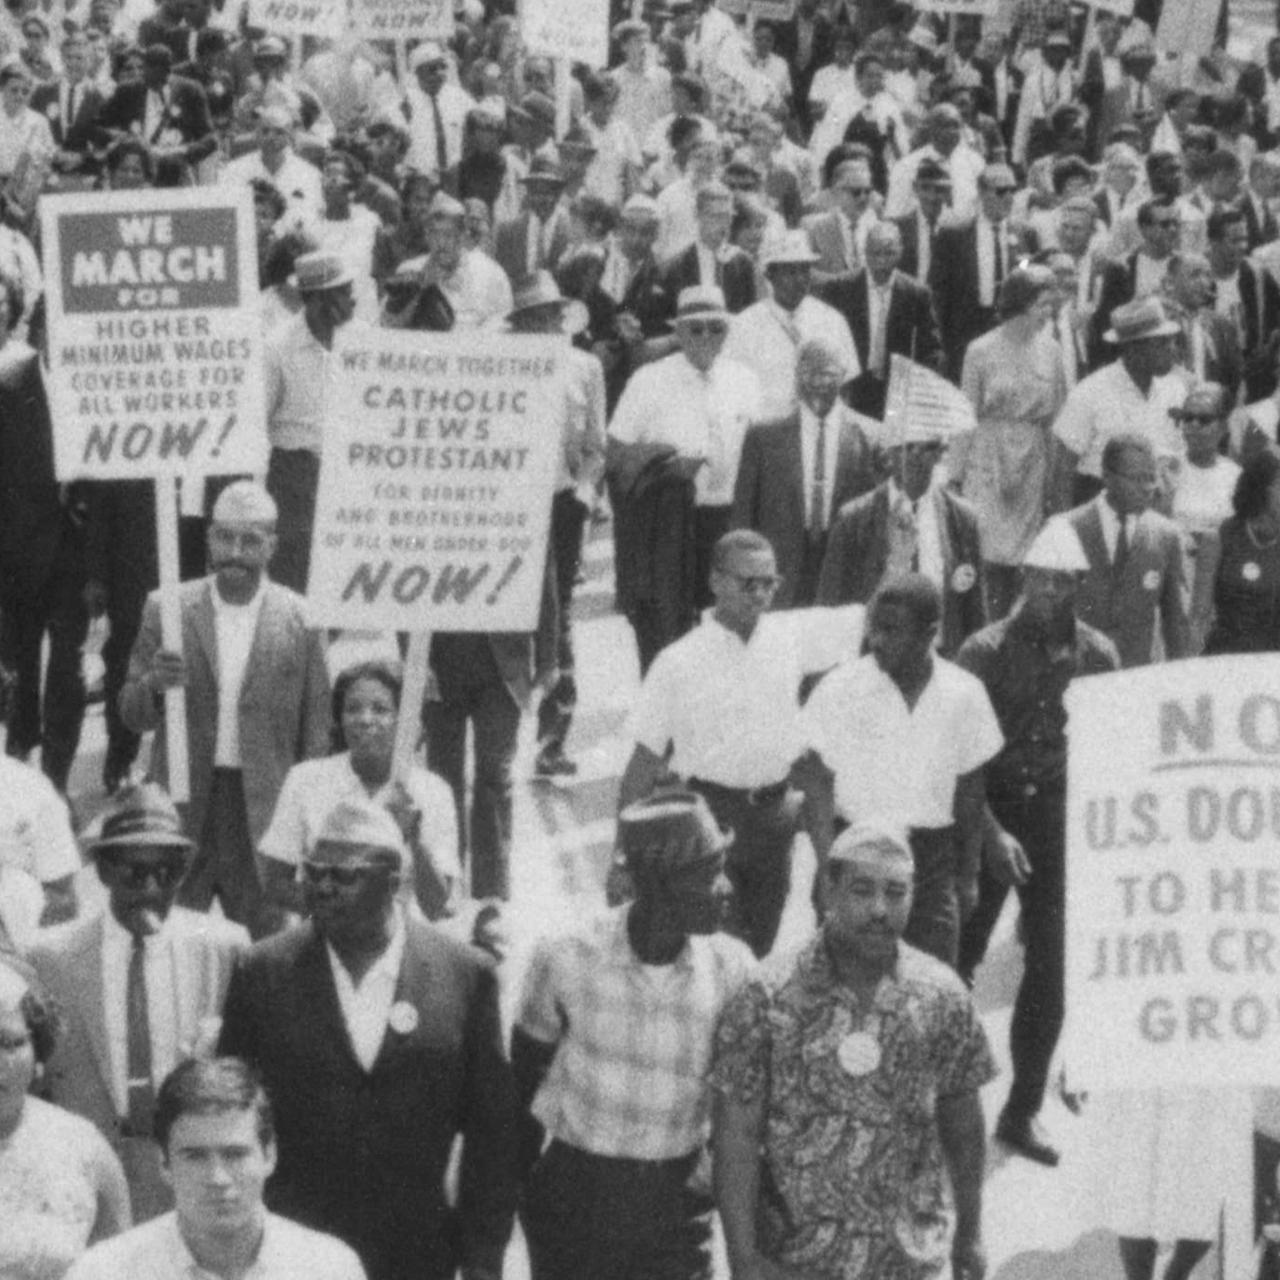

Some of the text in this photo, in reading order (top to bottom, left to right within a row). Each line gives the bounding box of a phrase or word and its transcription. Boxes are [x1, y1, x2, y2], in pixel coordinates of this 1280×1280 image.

[117, 214, 173, 246] WE
[72, 244, 227, 288] MARCH
[117, 287, 181, 307] FOR
[96, 315, 212, 339] HIGHER
[61, 337, 253, 366] MINIMUM WAGES
[342, 350, 555, 377] WE MARCH TOGETHER
[71, 365, 246, 393] COVERAGE FOR
[79, 389, 238, 416] ALL WORKERS
[363, 383, 528, 415] CATHOLIC
[82, 413, 238, 465] NOW!
[391, 416, 490, 441] JEWS
[347, 442, 530, 471] PROTESTANT
[391, 533, 426, 551] MEN
[341, 555, 523, 606] NOW!
[1082, 791, 1172, 852] U.S.
[1116, 869, 1187, 919] TO
[1089, 929, 1187, 983] JIM
